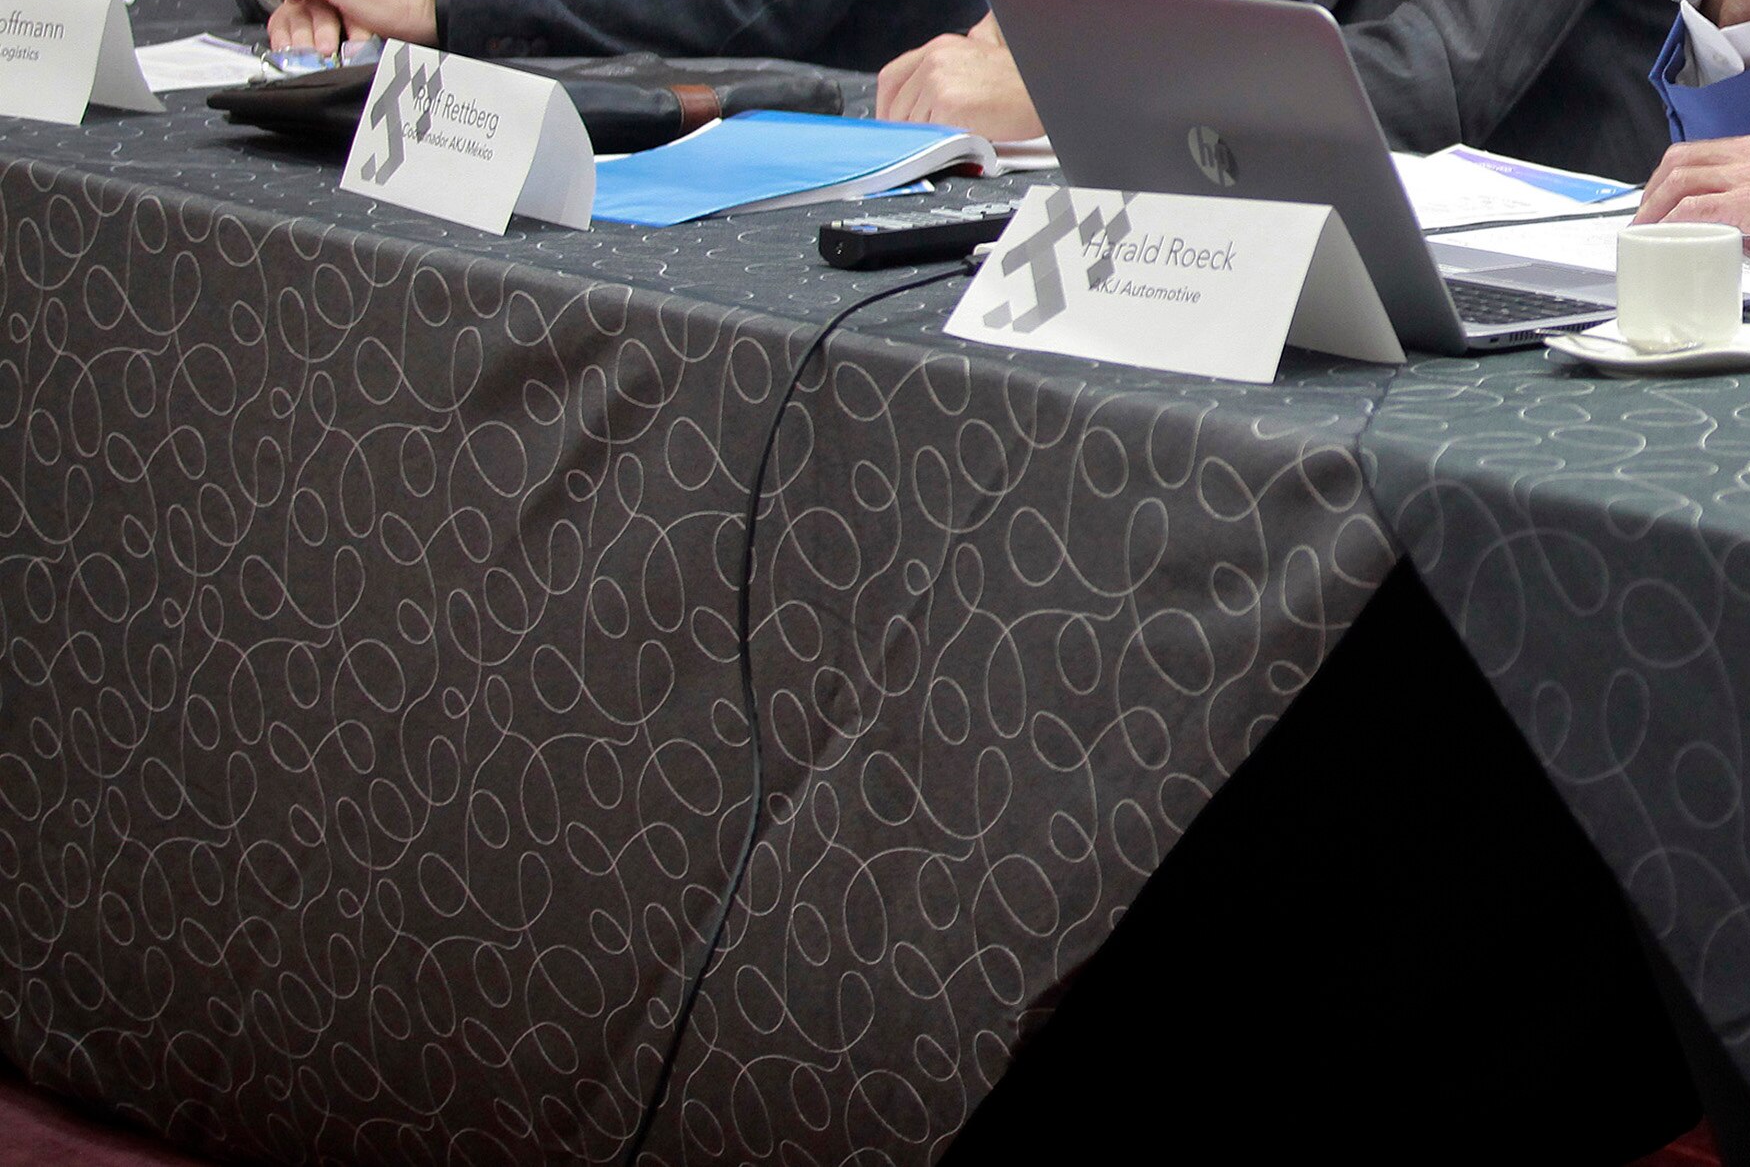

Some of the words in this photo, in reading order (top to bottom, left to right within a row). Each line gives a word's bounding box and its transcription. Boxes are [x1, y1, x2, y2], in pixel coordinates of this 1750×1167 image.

[413, 85, 445, 115] Rolf
[441, 92, 500, 140] Rettberg
[402, 121, 449, 148] Cooinador
[448, 135, 467, 153] AKJ
[465, 138, 494, 161] México
[1082, 231, 1165, 265] Harald
[1164, 237, 1238, 271] Roeck
[1088, 277, 1122, 295] AKJ
[1120, 280, 1202, 305] Automotive
